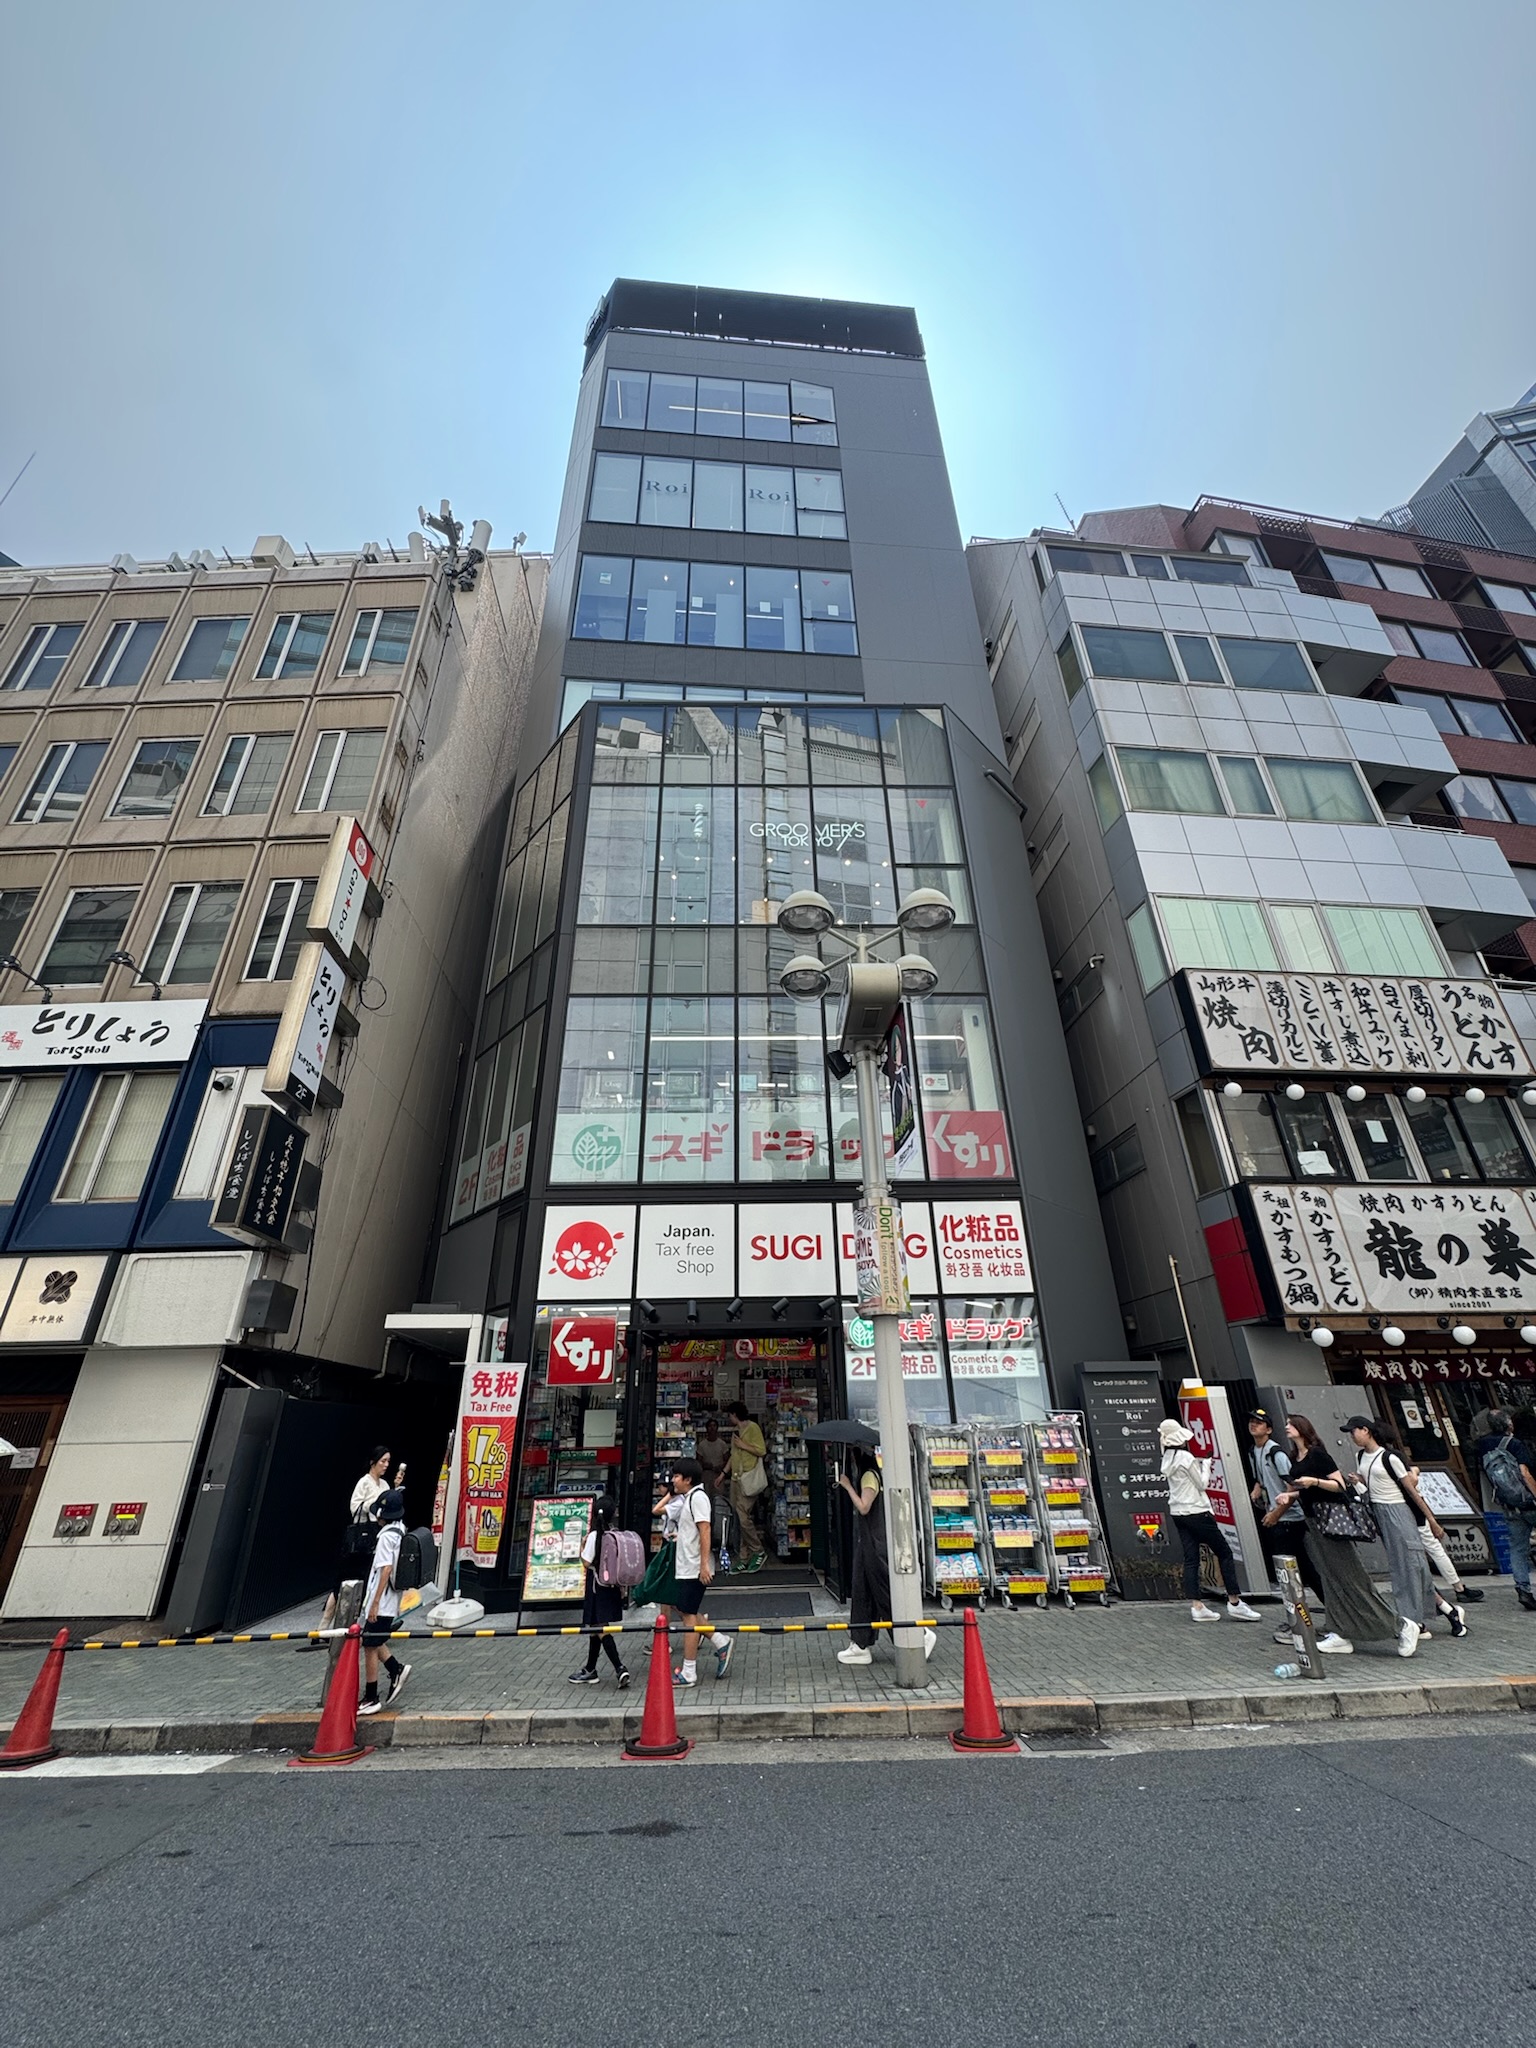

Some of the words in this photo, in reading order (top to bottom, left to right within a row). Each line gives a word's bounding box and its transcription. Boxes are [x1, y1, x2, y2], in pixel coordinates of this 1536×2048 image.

[645, 480, 688, 494] Roi
[750, 488, 791, 502] Roi
[1197, 974, 1256, 993] 山形牛
[1460, 985, 1495, 1010] 名物
[31, 1008, 171, 1047] とりしょう
[1202, 994, 1279, 1066] 焼肉
[1265, 981, 1309, 1064] 薄切りカルビ
[1322, 980, 1372, 1067] 牛すじ煮込
[1350, 982, 1395, 1067] 和牛ユッケ
[1379, 982, 1430, 1069] 白せんまい刺
[1407, 984, 1452, 1069] 厚切りタン
[294, 1083, 308, 1100] 2F
[649, 1123, 728, 1164] スギ
[930, 1113, 1005, 1177] くすり
[458, 1170, 479, 1206] 2F
[1262, 1190, 1291, 1209] 元祖
[1299, 1190, 1327, 1208] 名物
[662, 1224, 715, 1239] Japan.
[878, 1207, 894, 1239] Don't
[940, 1214, 1019, 1243] 化粧品
[655, 1243, 683, 1257] Tax
[686, 1242, 715, 1257] free
[750, 1235, 822, 1261] SUGI
[943, 1245, 1023, 1260] Cosmetics
[1270, 1209, 1320, 1307] かすもつ鍋
[1308, 1210, 1359, 1307] かすうどん
[1363, 1217, 1536, 1282] 龍の巣
[676, 1259, 715, 1275] Shop
[946, 1262, 983, 1278] 화장품
[987, 1262, 1026, 1277] 化妆品
[29, 1315, 64, 1324] 年中無休
[945, 1317, 1033, 1341] ドラッグ
[553, 1321, 613, 1380] くすり
[951, 1354, 998, 1364] Cosmetics
[470, 1370, 519, 1398] 免税
[470, 1401, 488, 1412] Tax
[490, 1402, 513, 1412] Free
[1125, 1412, 1142, 1420] Roi
[467, 1425, 506, 1464] 17%
[467, 1463, 504, 1489] OFF
[962, 1583, 978, 1591] 498
